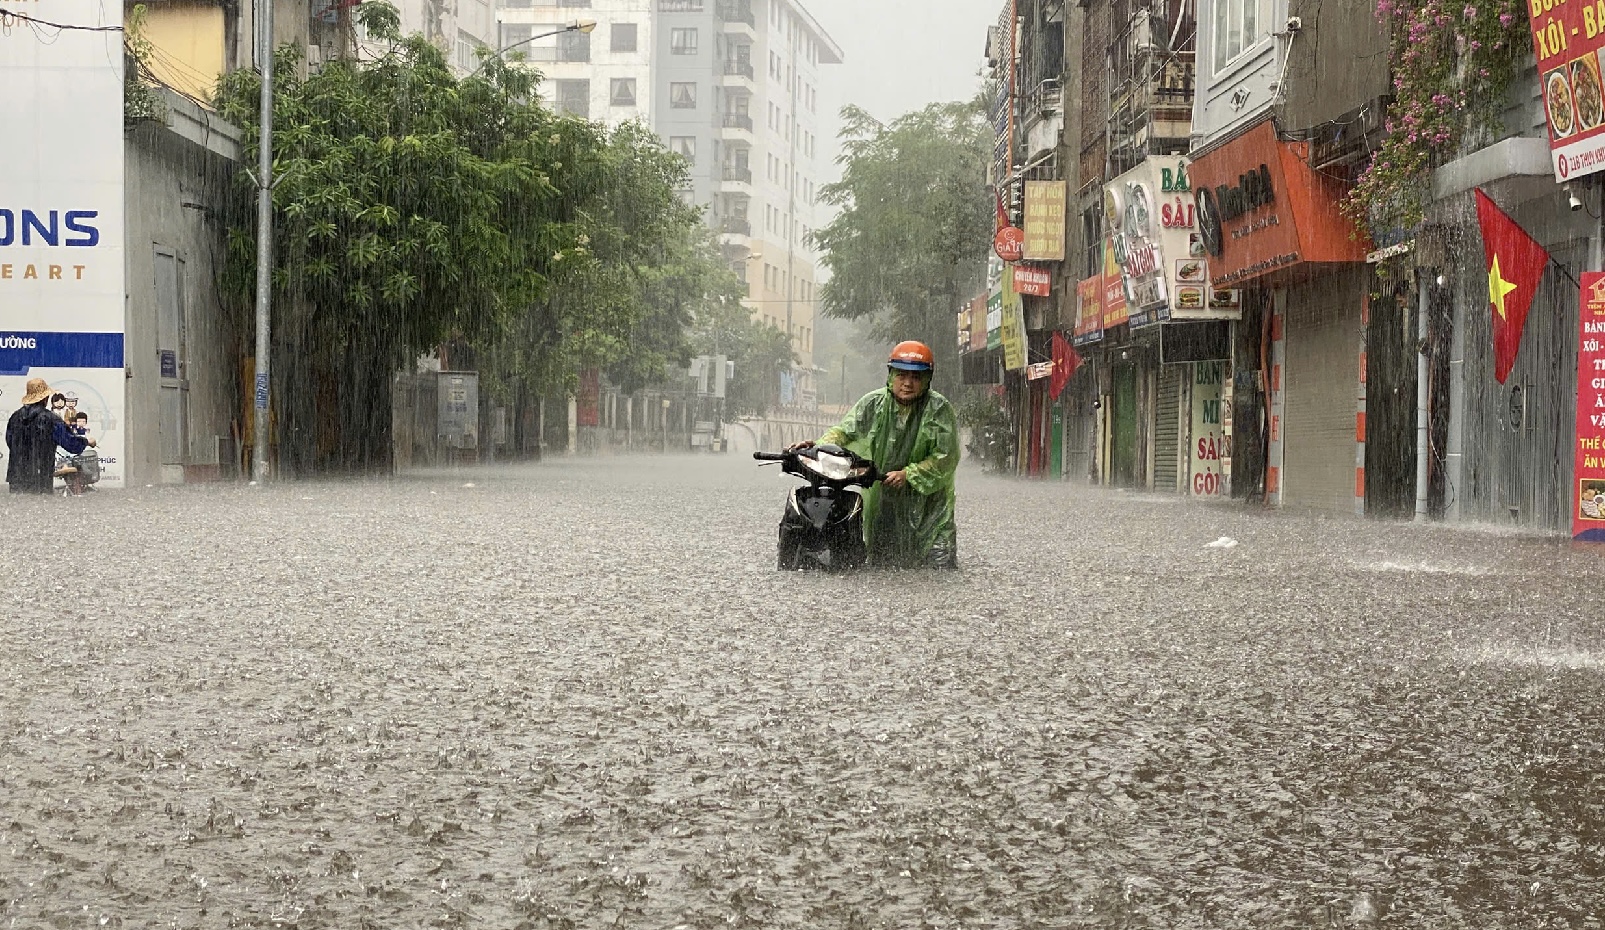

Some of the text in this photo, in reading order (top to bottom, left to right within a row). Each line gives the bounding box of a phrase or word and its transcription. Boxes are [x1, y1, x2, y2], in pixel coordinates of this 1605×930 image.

[1536, 17, 1567, 61] XÔI
[1161, 160, 1193, 193] BÁ
[1161, 195, 1195, 229] SÀI
[1, 263, 86, 280] EART
[1584, 319, 1605, 333] BÁN
[1583, 338, 1599, 352] XÔI
[1580, 435, 1600, 450] THẾ
[1583, 453, 1598, 468] ĂN
